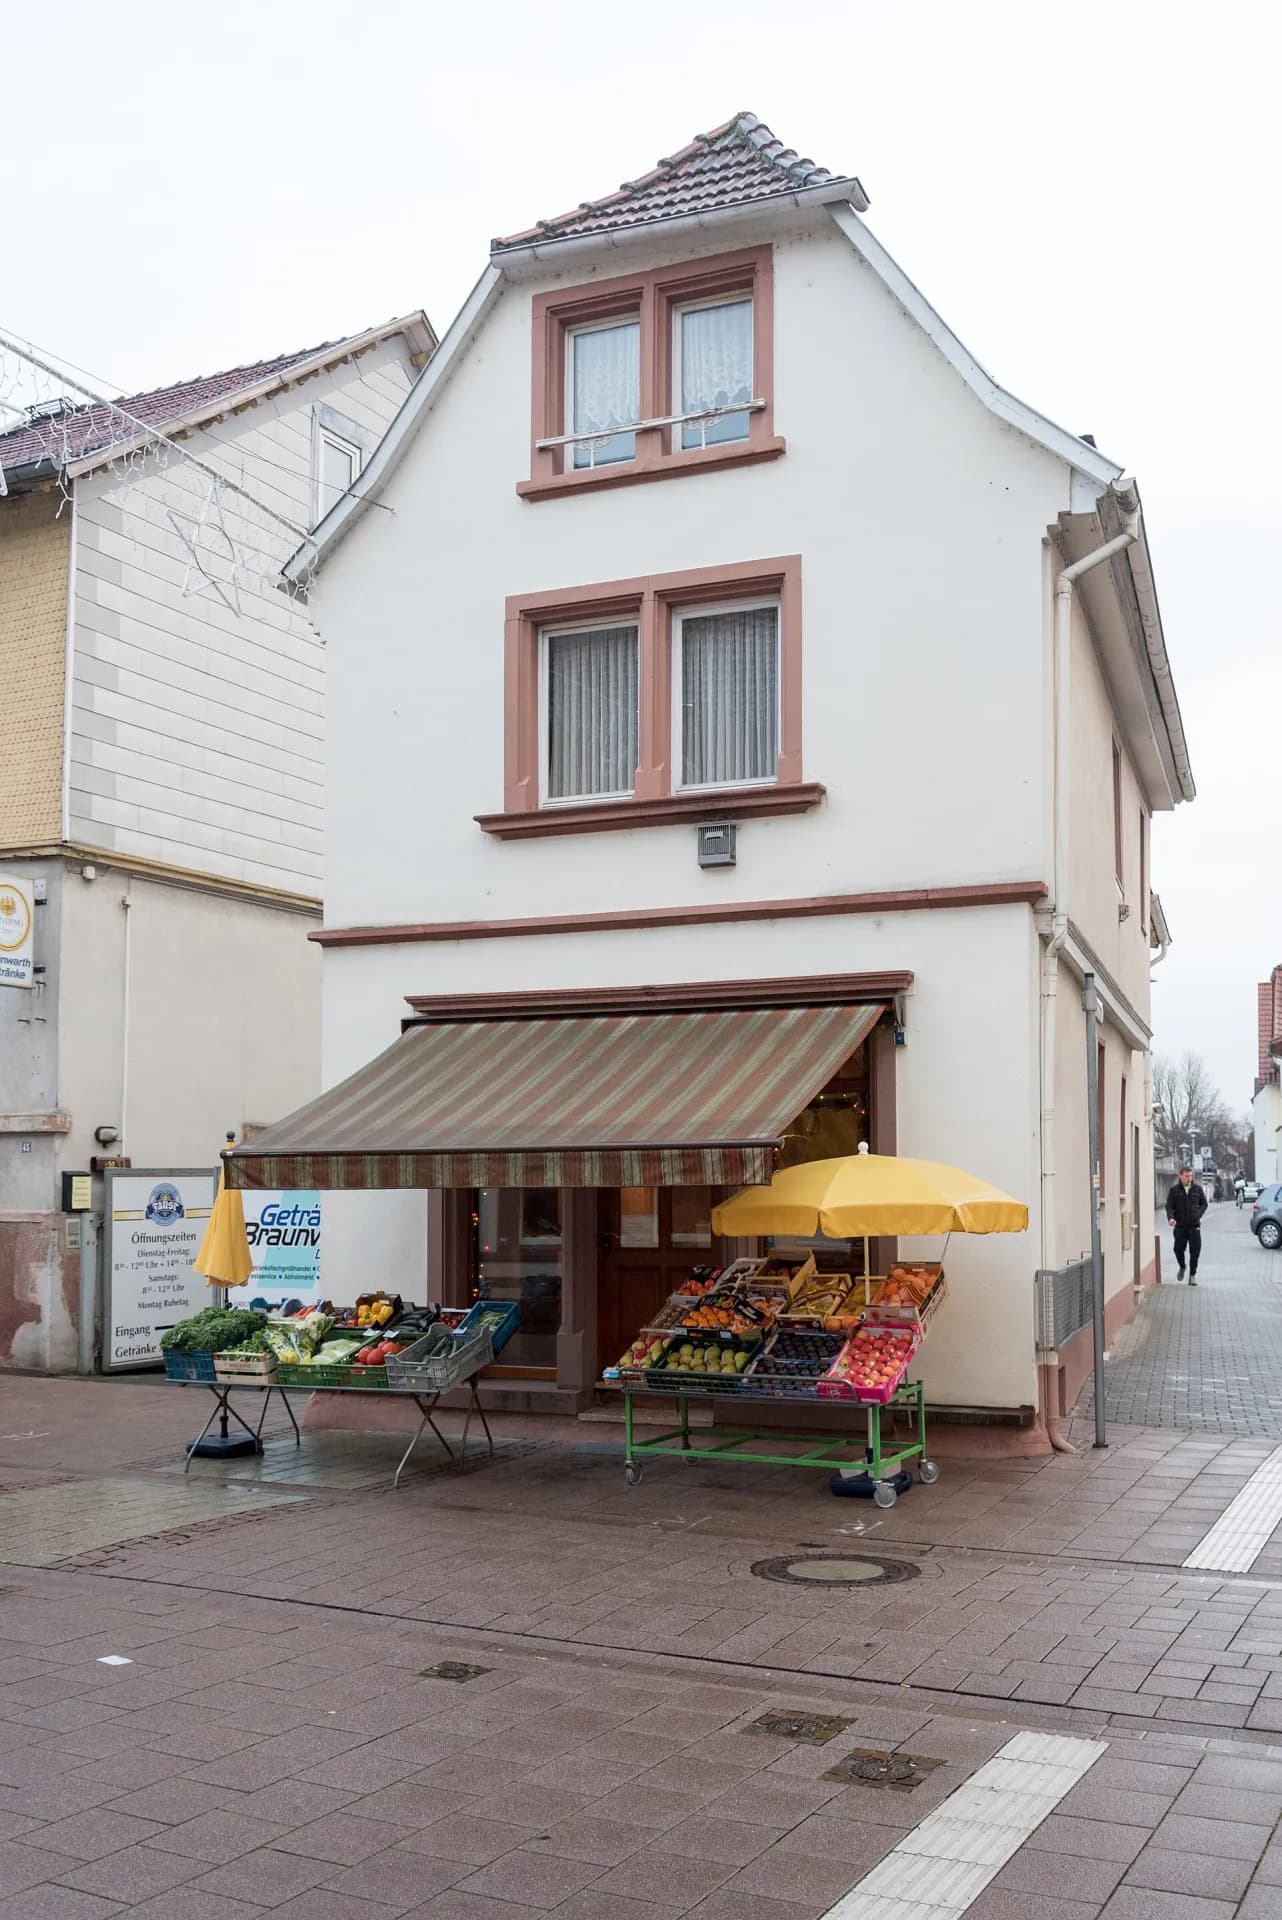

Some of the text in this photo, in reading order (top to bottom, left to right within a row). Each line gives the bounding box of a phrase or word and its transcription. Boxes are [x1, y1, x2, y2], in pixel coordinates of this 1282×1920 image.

[0, 956, 31, 968] nwarth
[131, 1232, 196, 1245] Öffnungszeiten
[146, 1261, 158, 1269] Uhr
[173, 1283, 184, 1291] Uhr
[164, 1299, 188, 1307] Ruhetag
[115, 1326, 150, 1338] Eingang
[115, 1344, 156, 1357] Getränke
